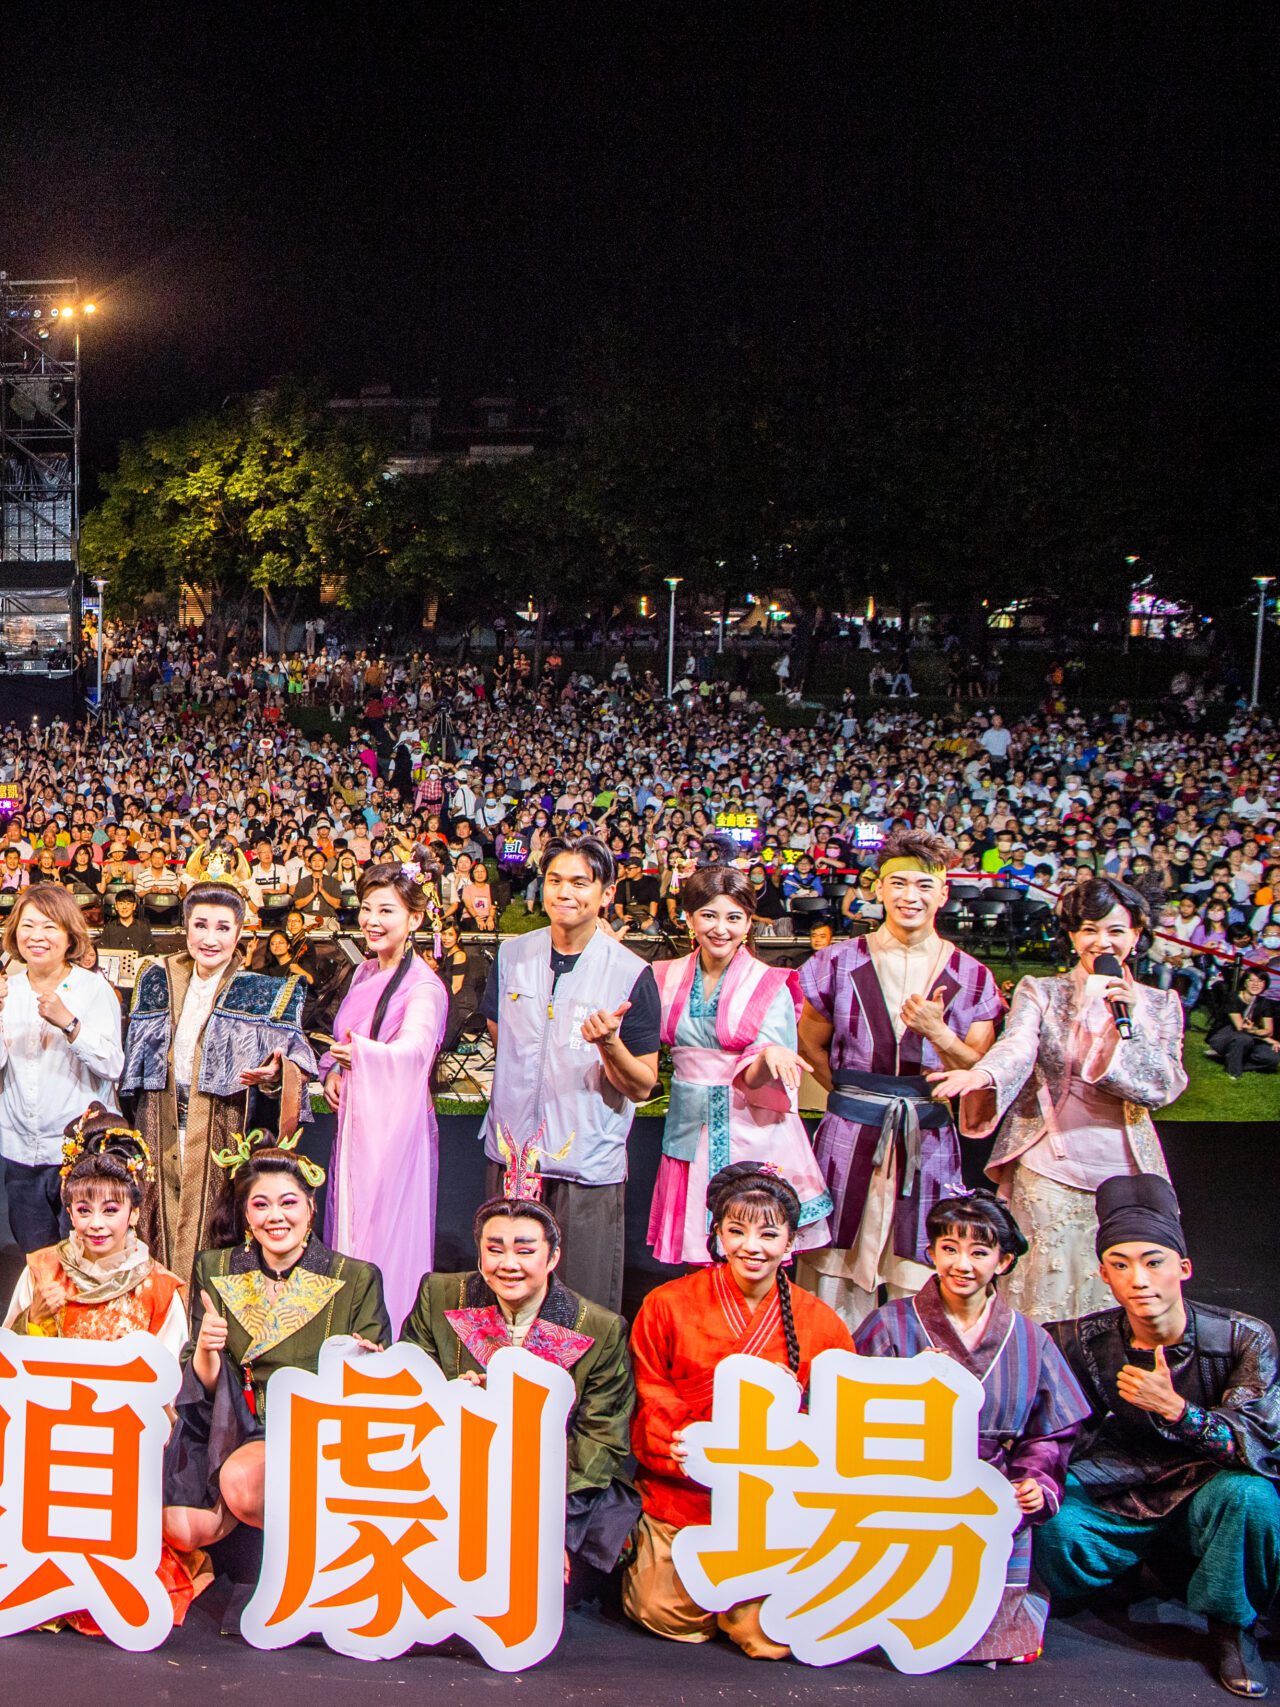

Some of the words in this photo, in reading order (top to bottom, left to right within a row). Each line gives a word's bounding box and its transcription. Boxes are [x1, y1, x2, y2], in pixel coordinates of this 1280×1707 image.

[504, 853, 526, 861] Henry
[265, 1360, 550, 1648] 劇
[696, 1375, 997, 1650] 場
